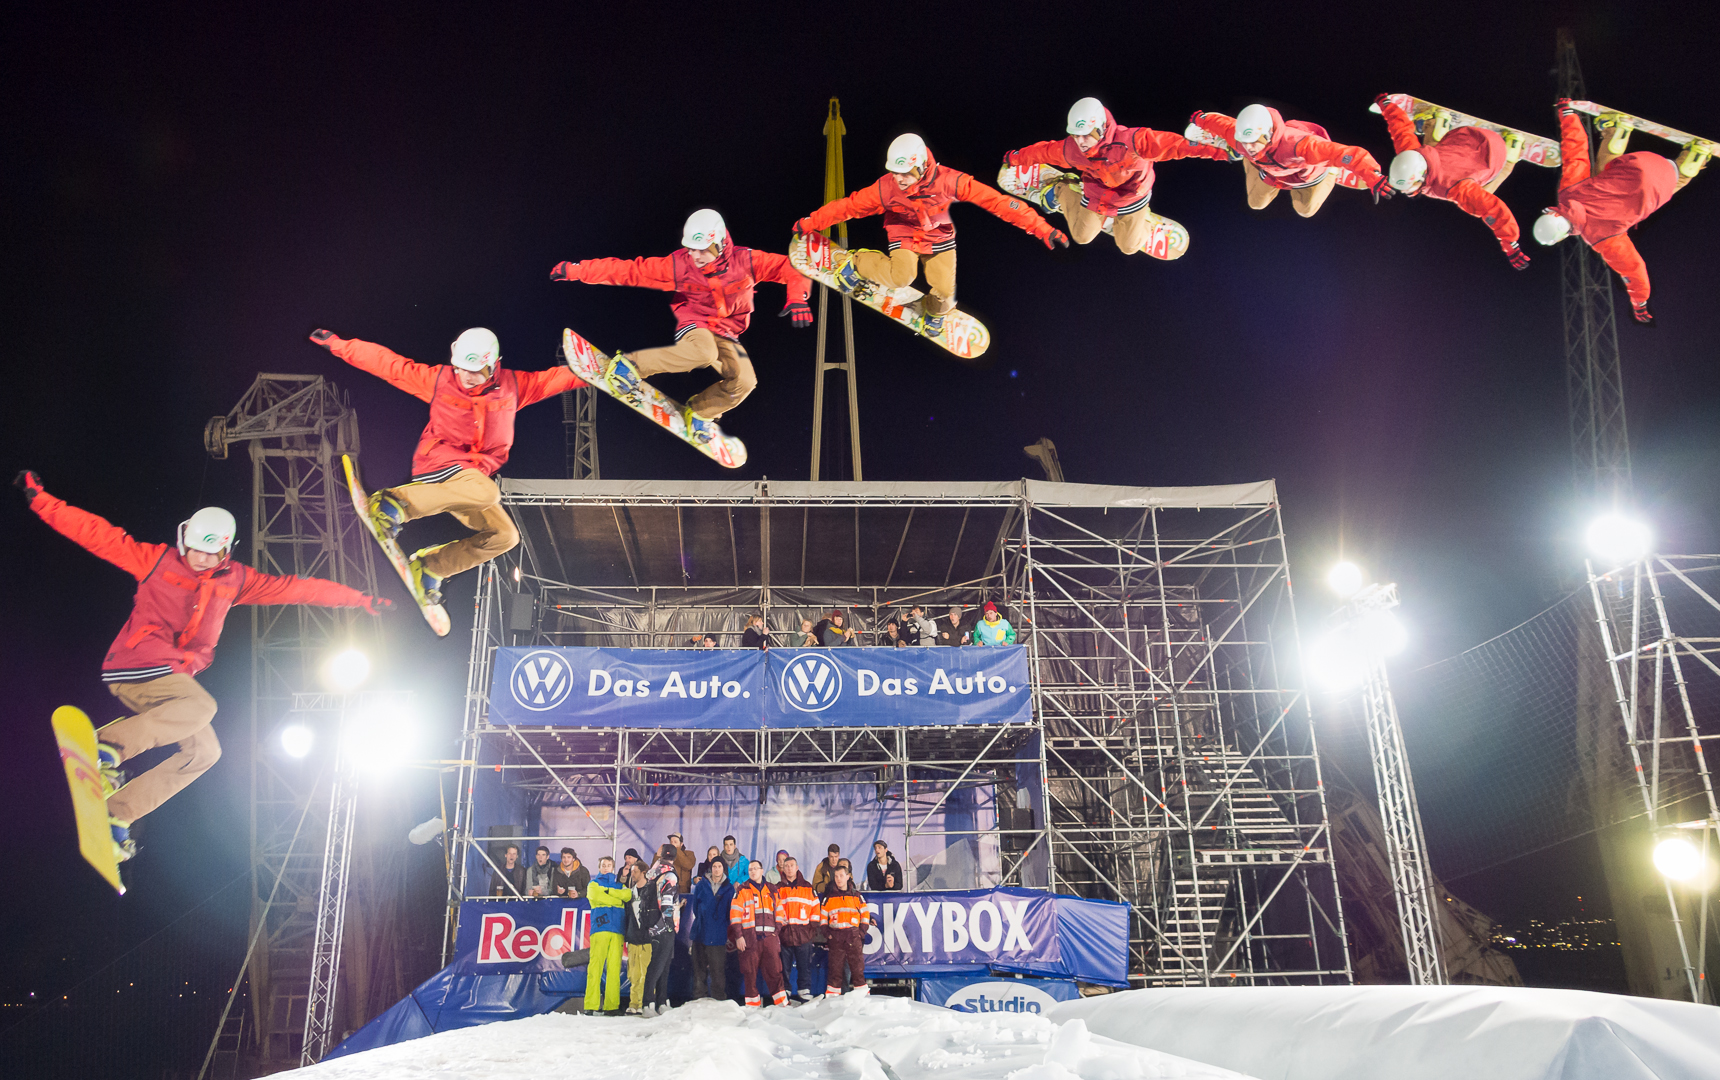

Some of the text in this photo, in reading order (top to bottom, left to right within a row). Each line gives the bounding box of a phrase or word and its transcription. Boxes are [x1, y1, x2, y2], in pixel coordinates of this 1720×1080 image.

[588, 669, 650, 697] Das
[659, 671, 750, 699] Auto.
[857, 669, 918, 696] Das
[928, 668, 1017, 695] Auto.
[479, 909, 576, 962] Red
[863, 900, 1033, 955] SKYBOX
[965, 995, 1041, 1013] studio
